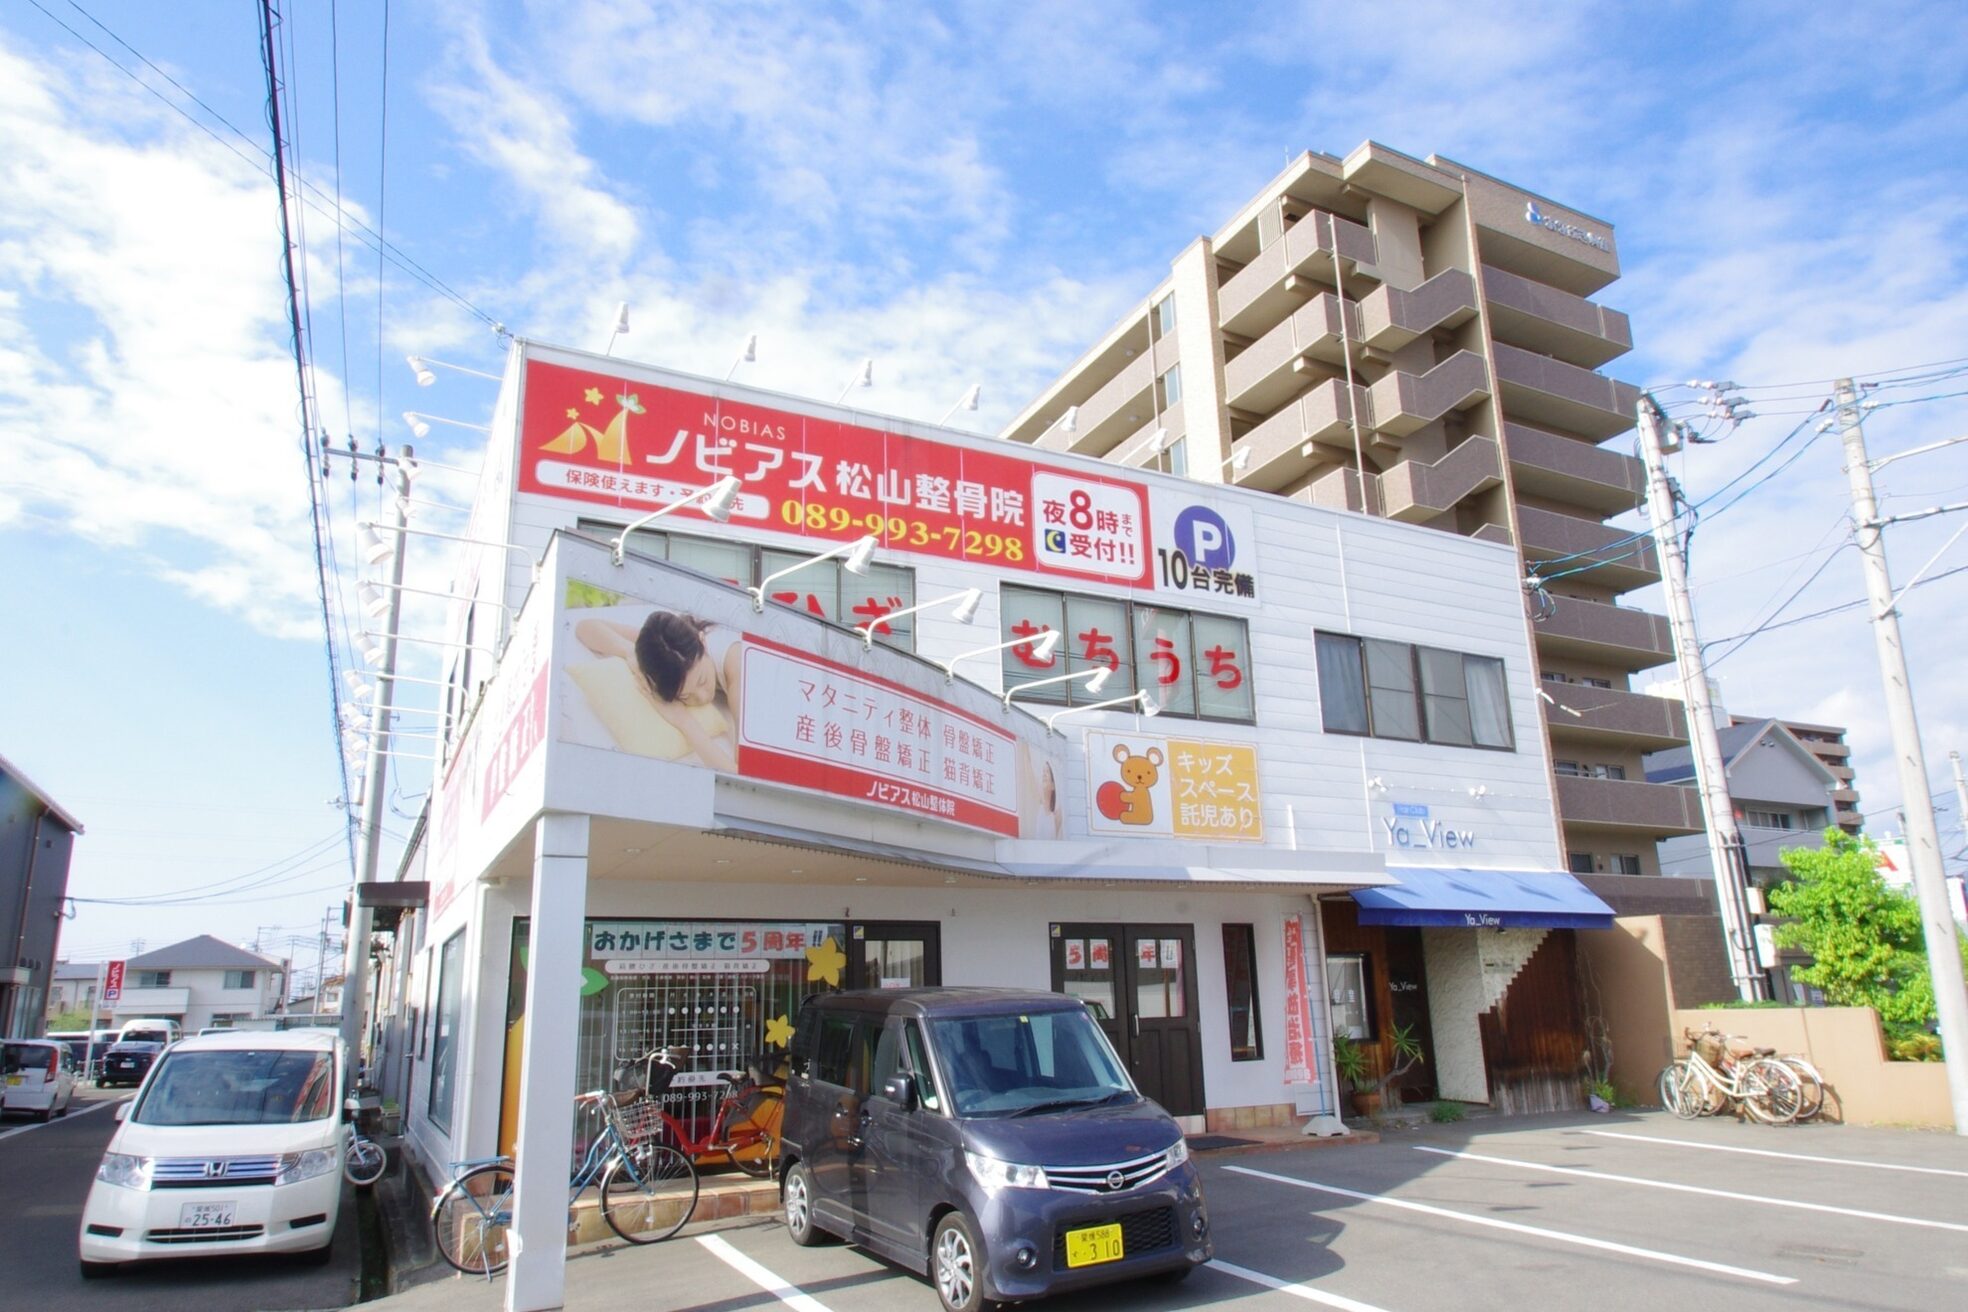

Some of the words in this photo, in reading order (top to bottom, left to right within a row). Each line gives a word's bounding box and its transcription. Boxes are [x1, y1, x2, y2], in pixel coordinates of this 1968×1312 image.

[703, 411, 787, 442] NOBIAS
[646, 428, 1025, 528] ノビアス松山整骨院
[780, 499, 1025, 562] 089-993-7298
[1158, 548, 1256, 599] 10台完備
[798, 678, 932, 741] マタニティ整体
[795, 713, 931, 775] 産後骨盤矯正
[1177, 751, 1233, 776] キッズ
[1180, 778, 1256, 802] スペース
[1180, 803, 1253, 831] 託児あり
